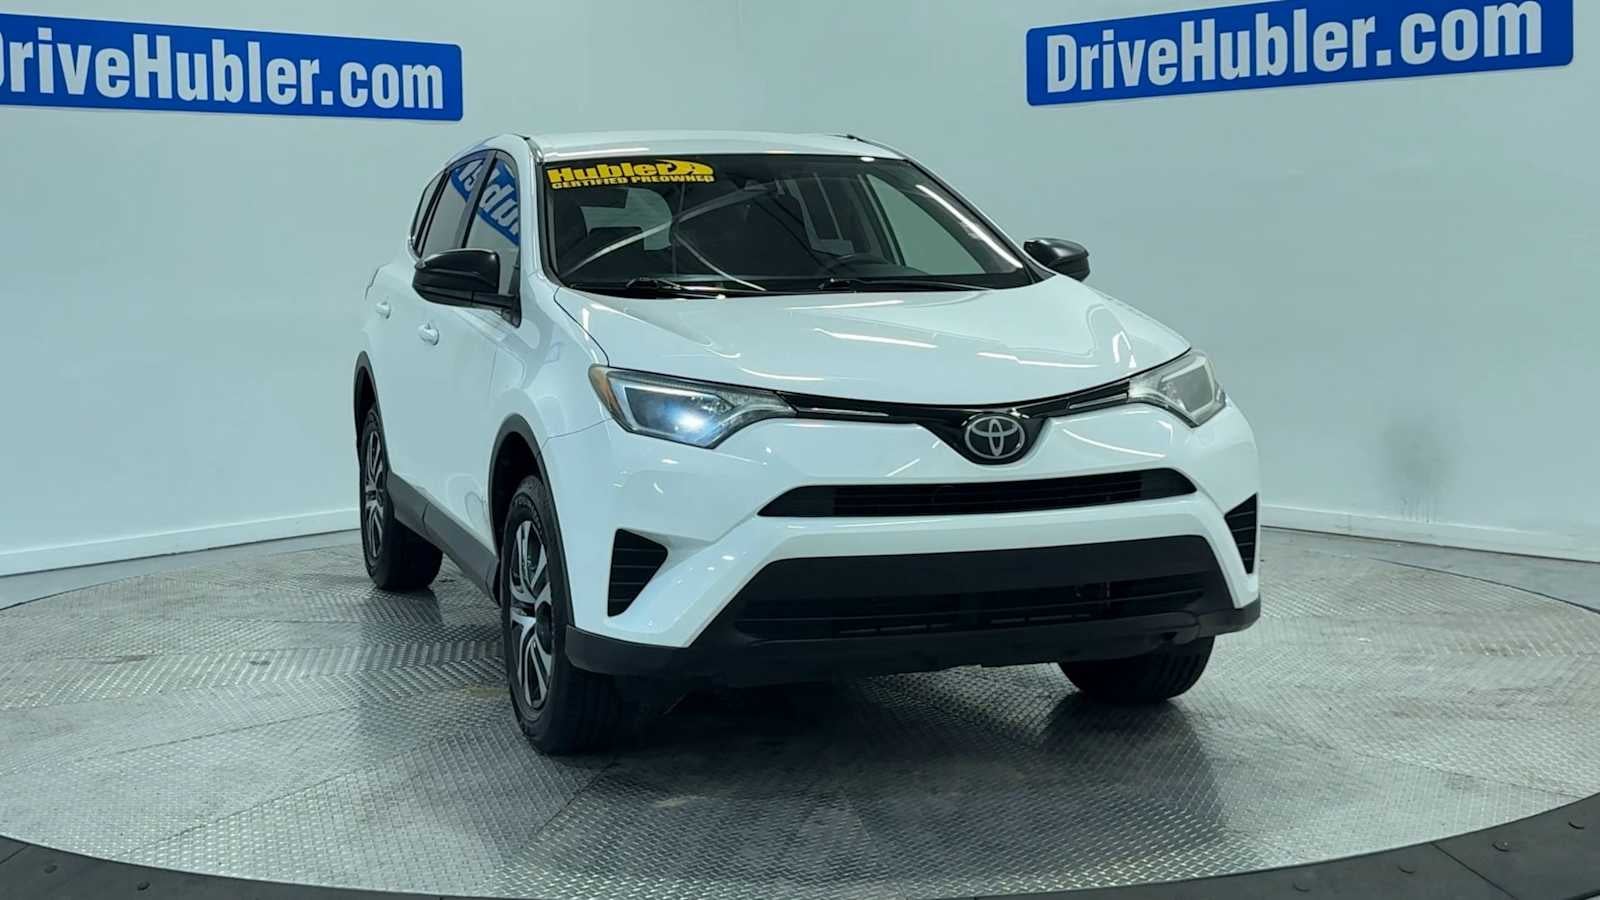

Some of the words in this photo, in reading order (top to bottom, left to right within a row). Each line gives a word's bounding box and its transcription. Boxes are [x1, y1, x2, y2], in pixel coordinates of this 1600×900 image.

[0, 28, 444, 109] riveHubler.com
[1047, 0, 1542, 93] DriveHubler.com
[547, 161, 676, 183] Hubler
[551, 177, 628, 189] CERTIFIED
